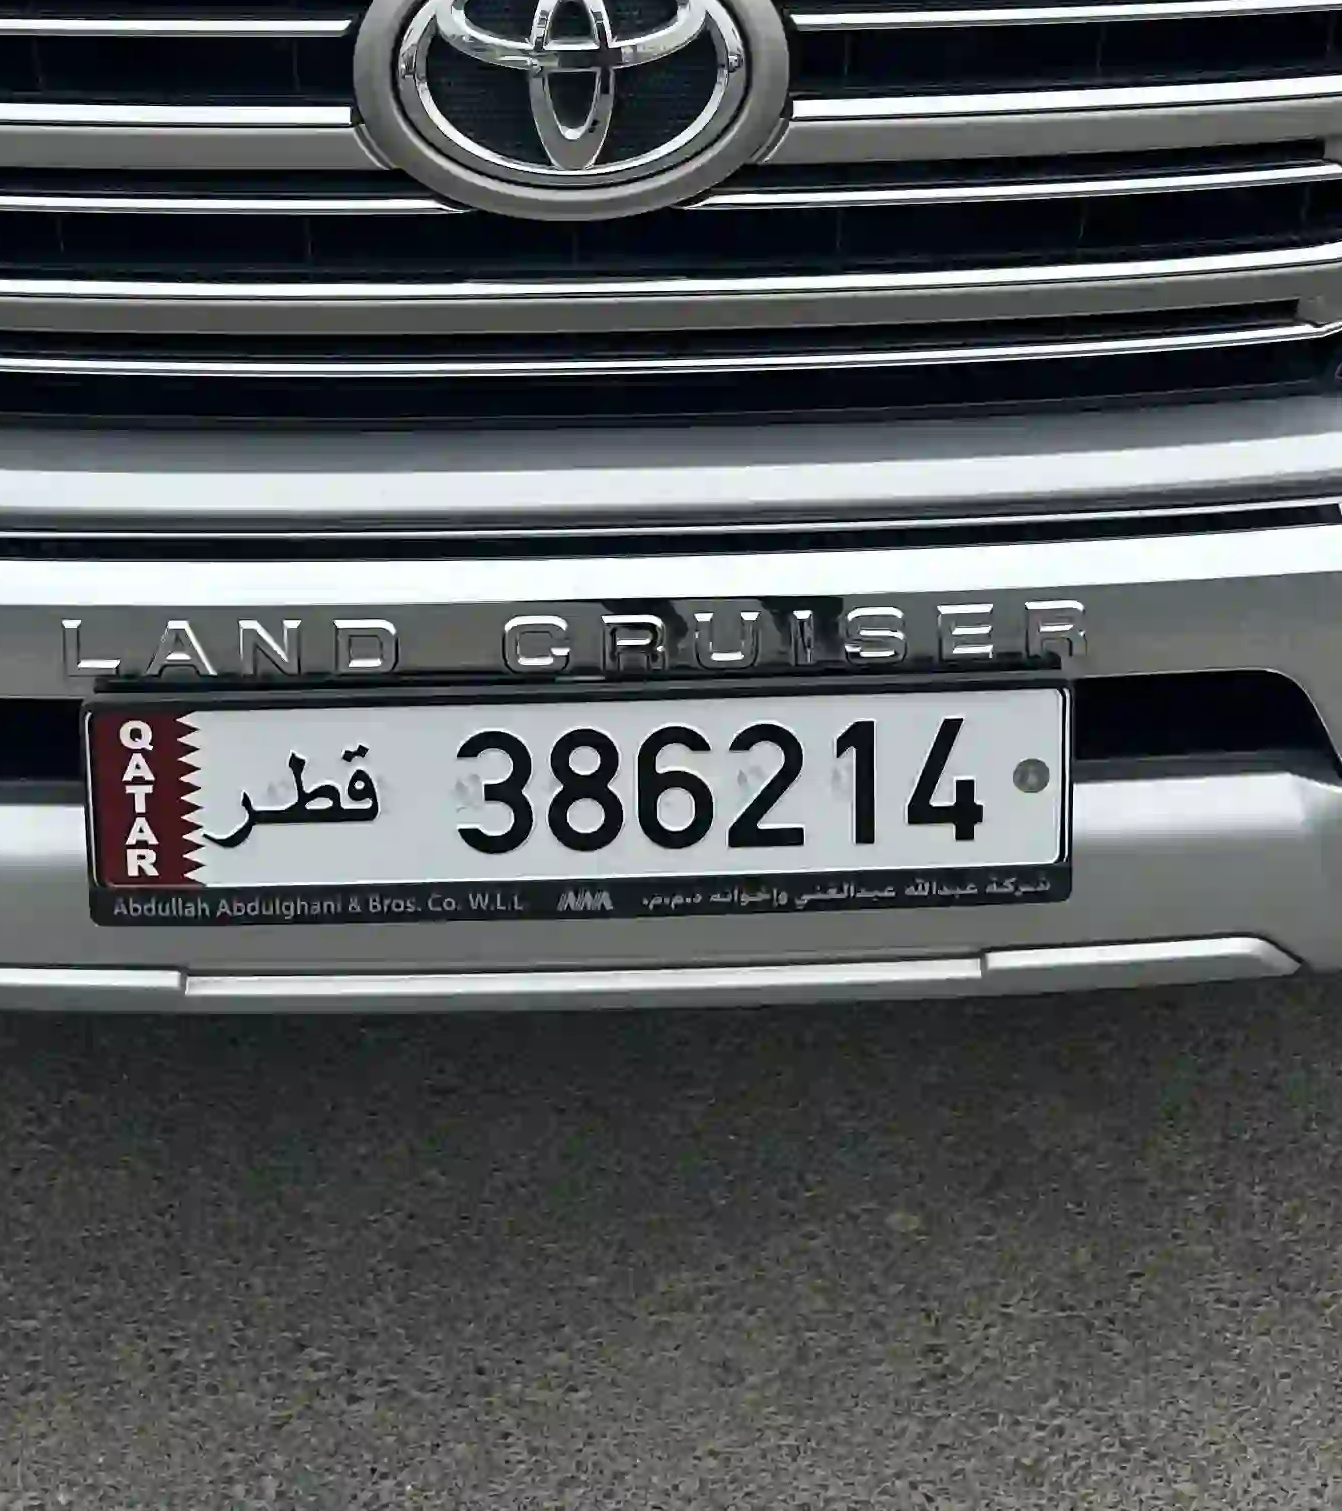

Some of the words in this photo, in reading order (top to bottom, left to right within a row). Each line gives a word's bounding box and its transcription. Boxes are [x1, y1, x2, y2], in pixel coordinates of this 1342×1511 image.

[62, 619, 400, 677] LAND
[501, 599, 1088, 675] CRUISER
[118, 719, 160, 878] QATAR
[201, 743, 380, 849] قطر
[455, 716, 984, 855] 386214
[113, 896, 210, 918] Abdullah
[215, 896, 342, 920] Abdulghani
[348, 894, 362, 913] &
[368, 892, 422, 914] Bros.
[427, 891, 461, 911] Co.
[985, 873, 1051, 897] شركة
